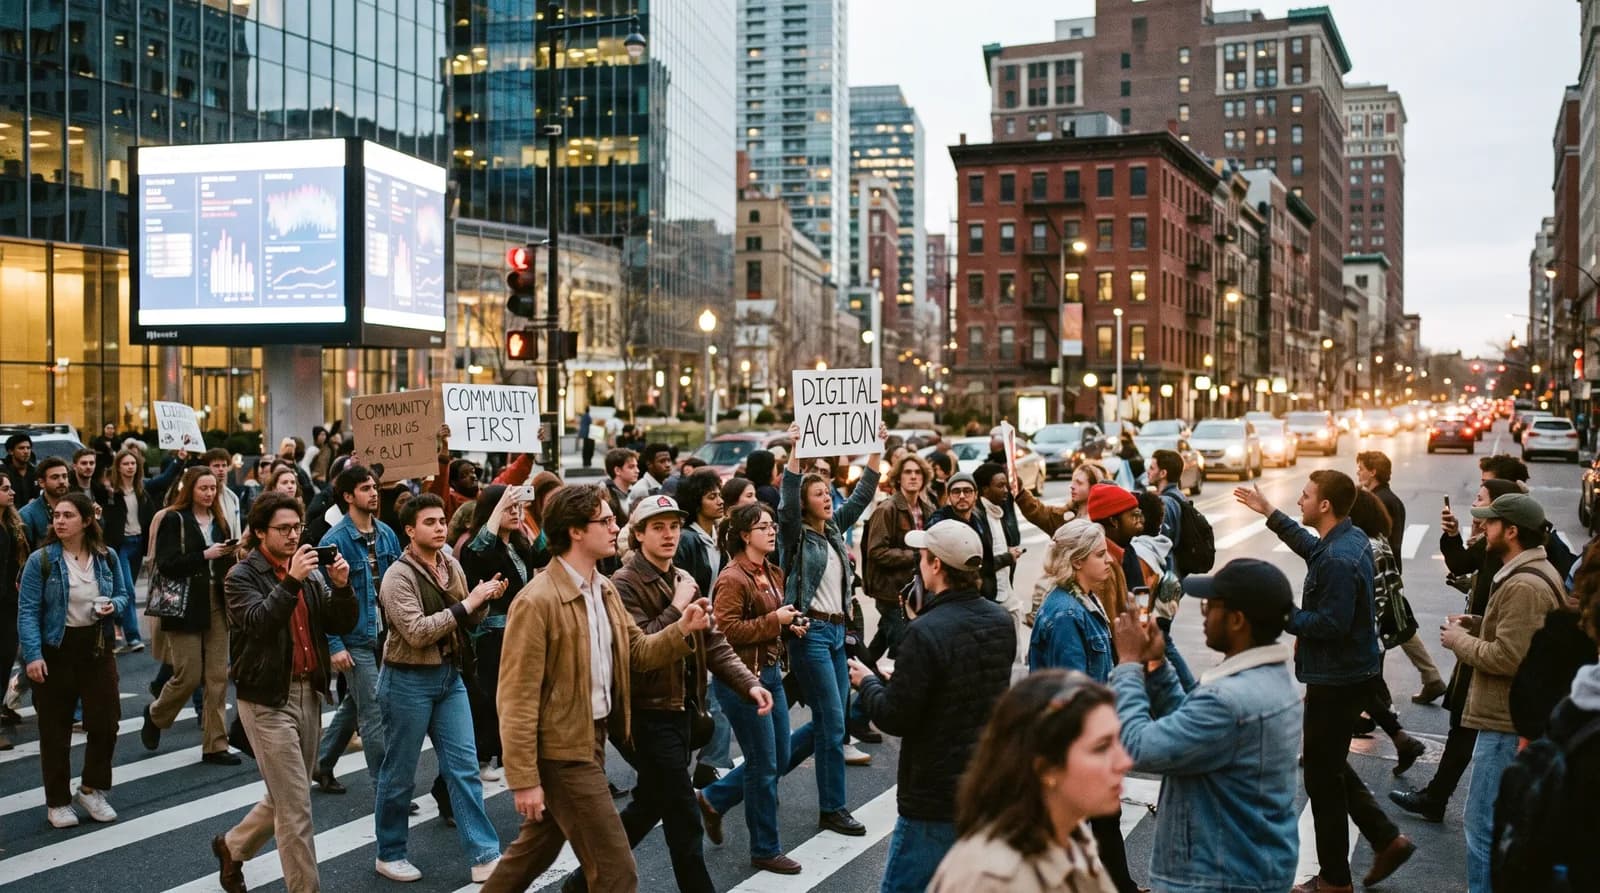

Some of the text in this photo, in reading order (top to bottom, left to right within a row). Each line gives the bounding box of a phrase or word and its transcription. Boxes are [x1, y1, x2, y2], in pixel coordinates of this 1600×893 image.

[447, 387, 537, 414] COMMUNITY
[801, 376, 878, 406] DIGITAL
[355, 399, 431, 421] COMMUNITY
[466, 417, 525, 444] FIRST
[801, 409, 877, 448] ACTION
